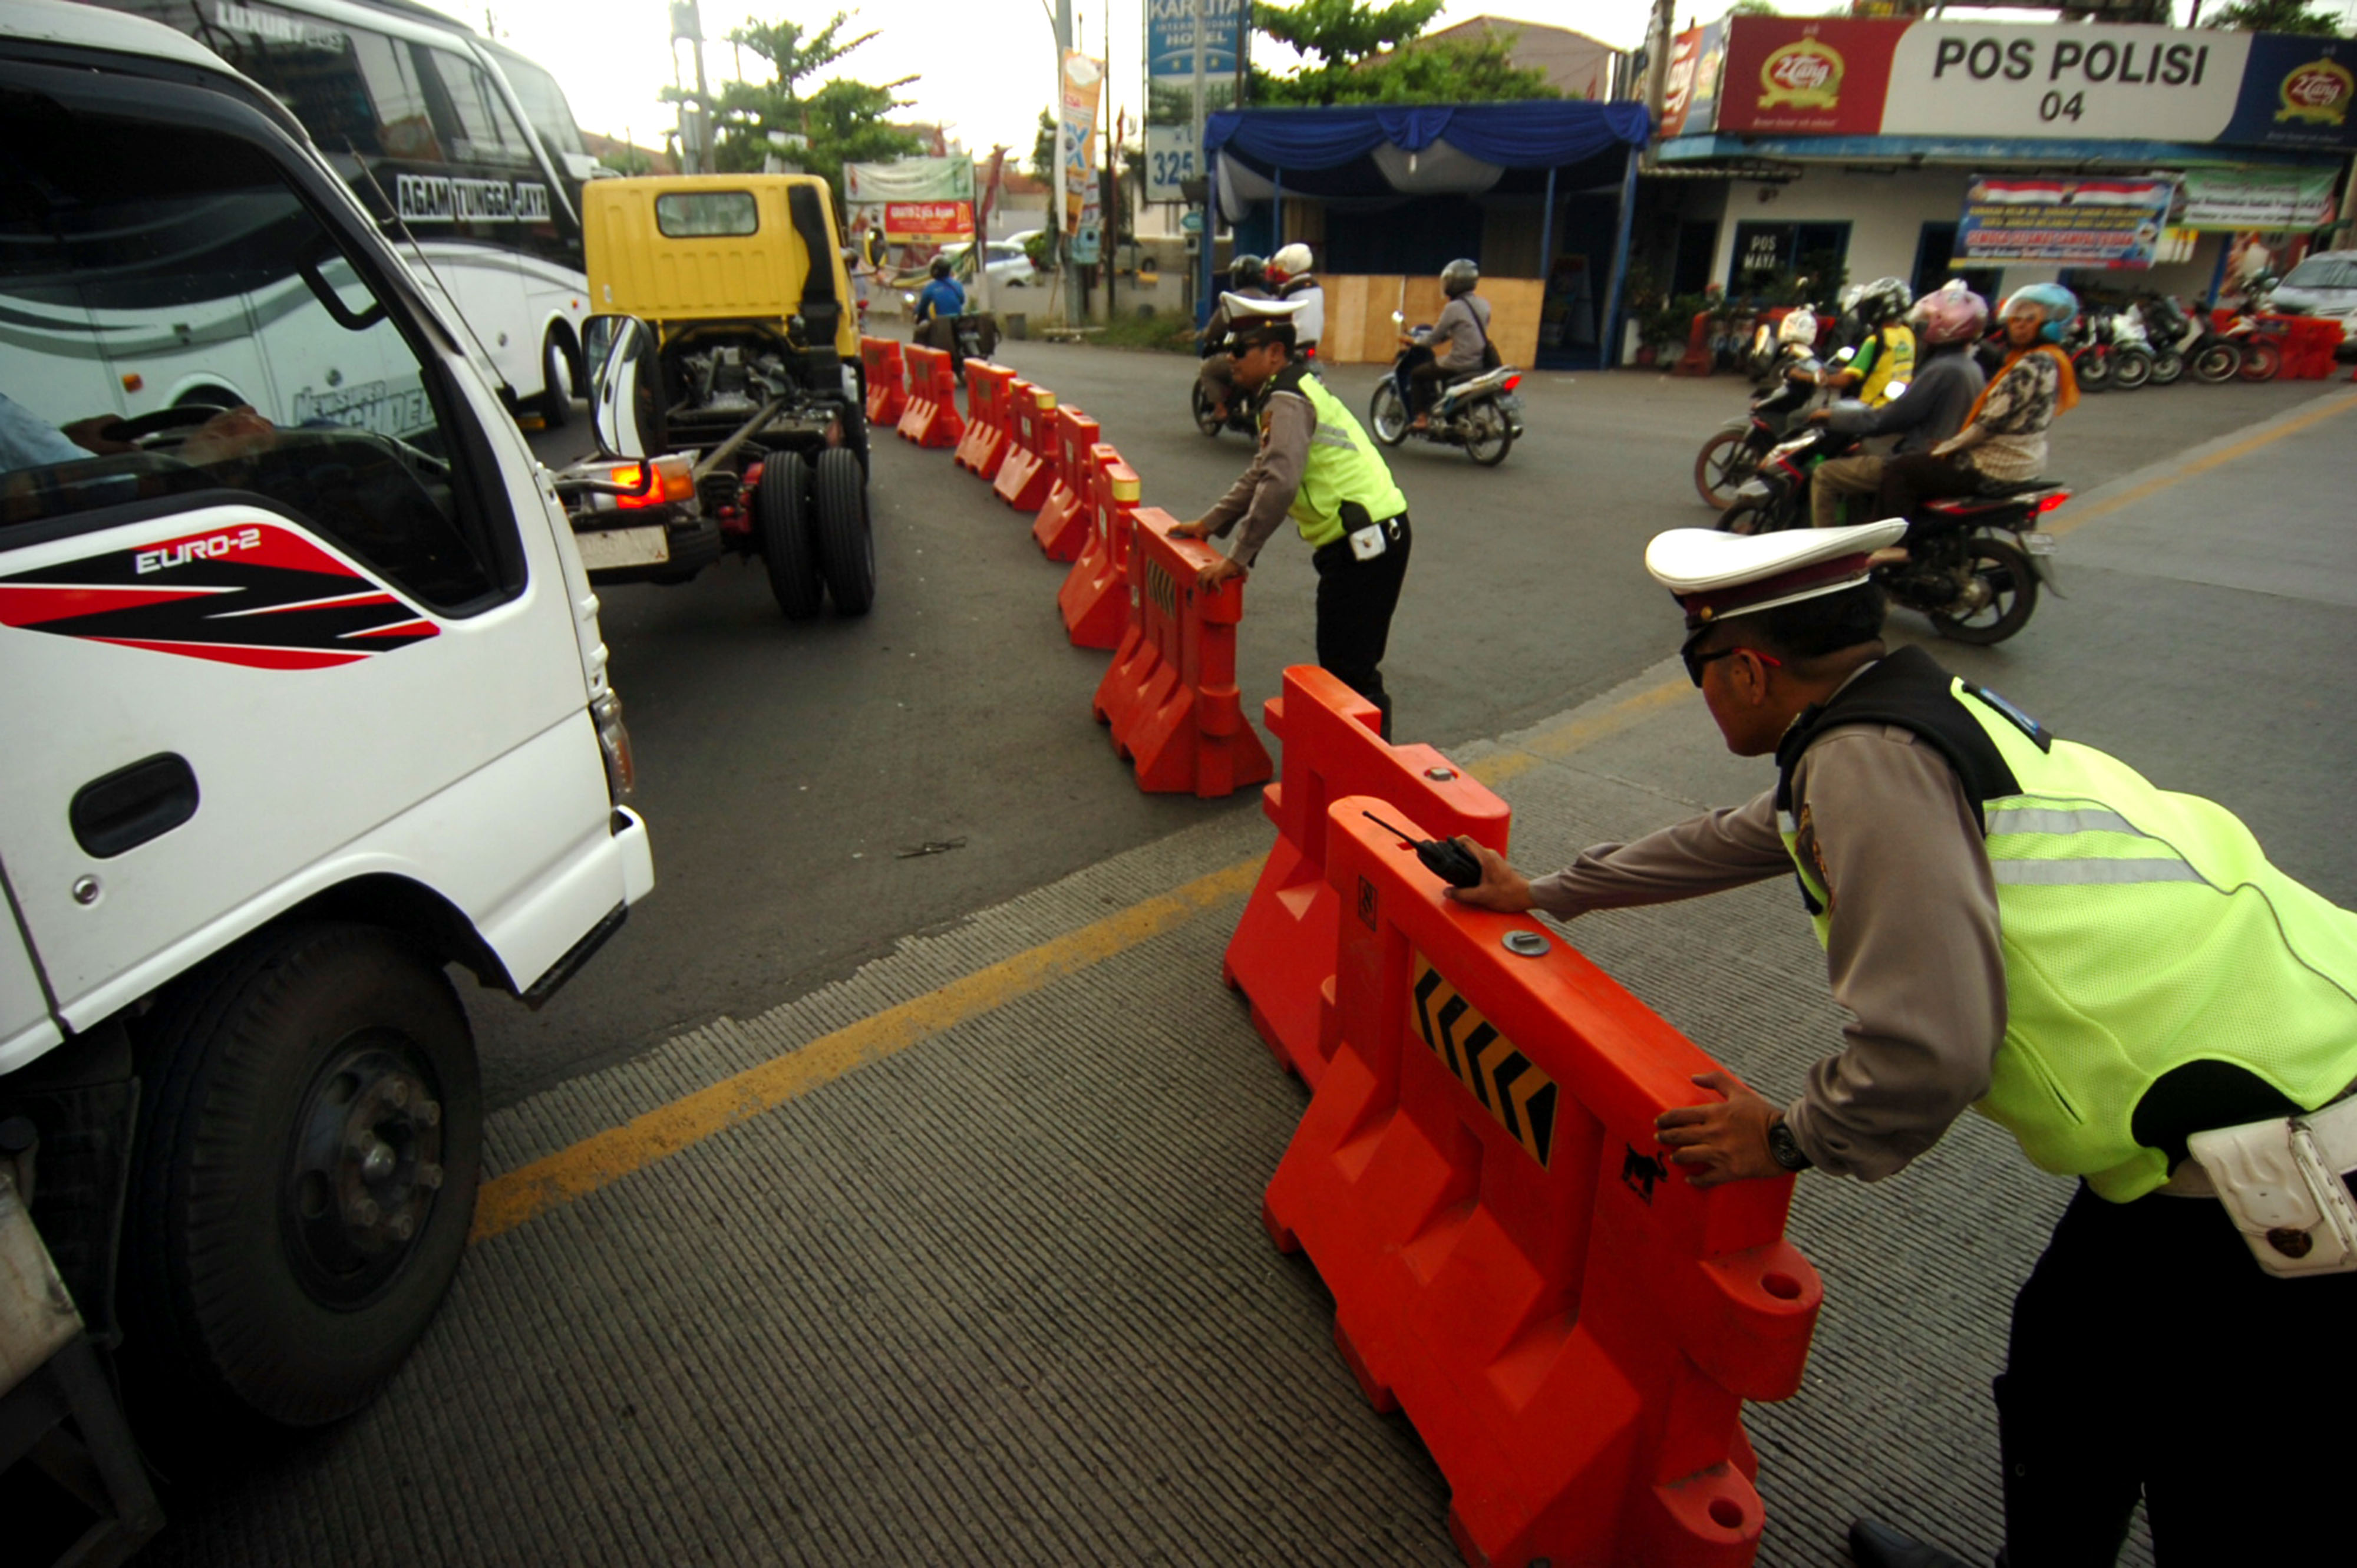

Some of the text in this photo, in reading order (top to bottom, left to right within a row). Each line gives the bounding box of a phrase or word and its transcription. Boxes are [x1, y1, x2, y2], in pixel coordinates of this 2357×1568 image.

[1150, 0, 1240, 19] KARITA
[1166, 31, 1228, 47] HOEL
[1933, 37, 2210, 87] POS POLISI
[2039, 90, 2086, 122] 04
[397, 174, 551, 222] AGAM TUNGGA JAYA
[1751, 235, 1777, 251] POS
[135, 528, 261, 575] EURO-2
